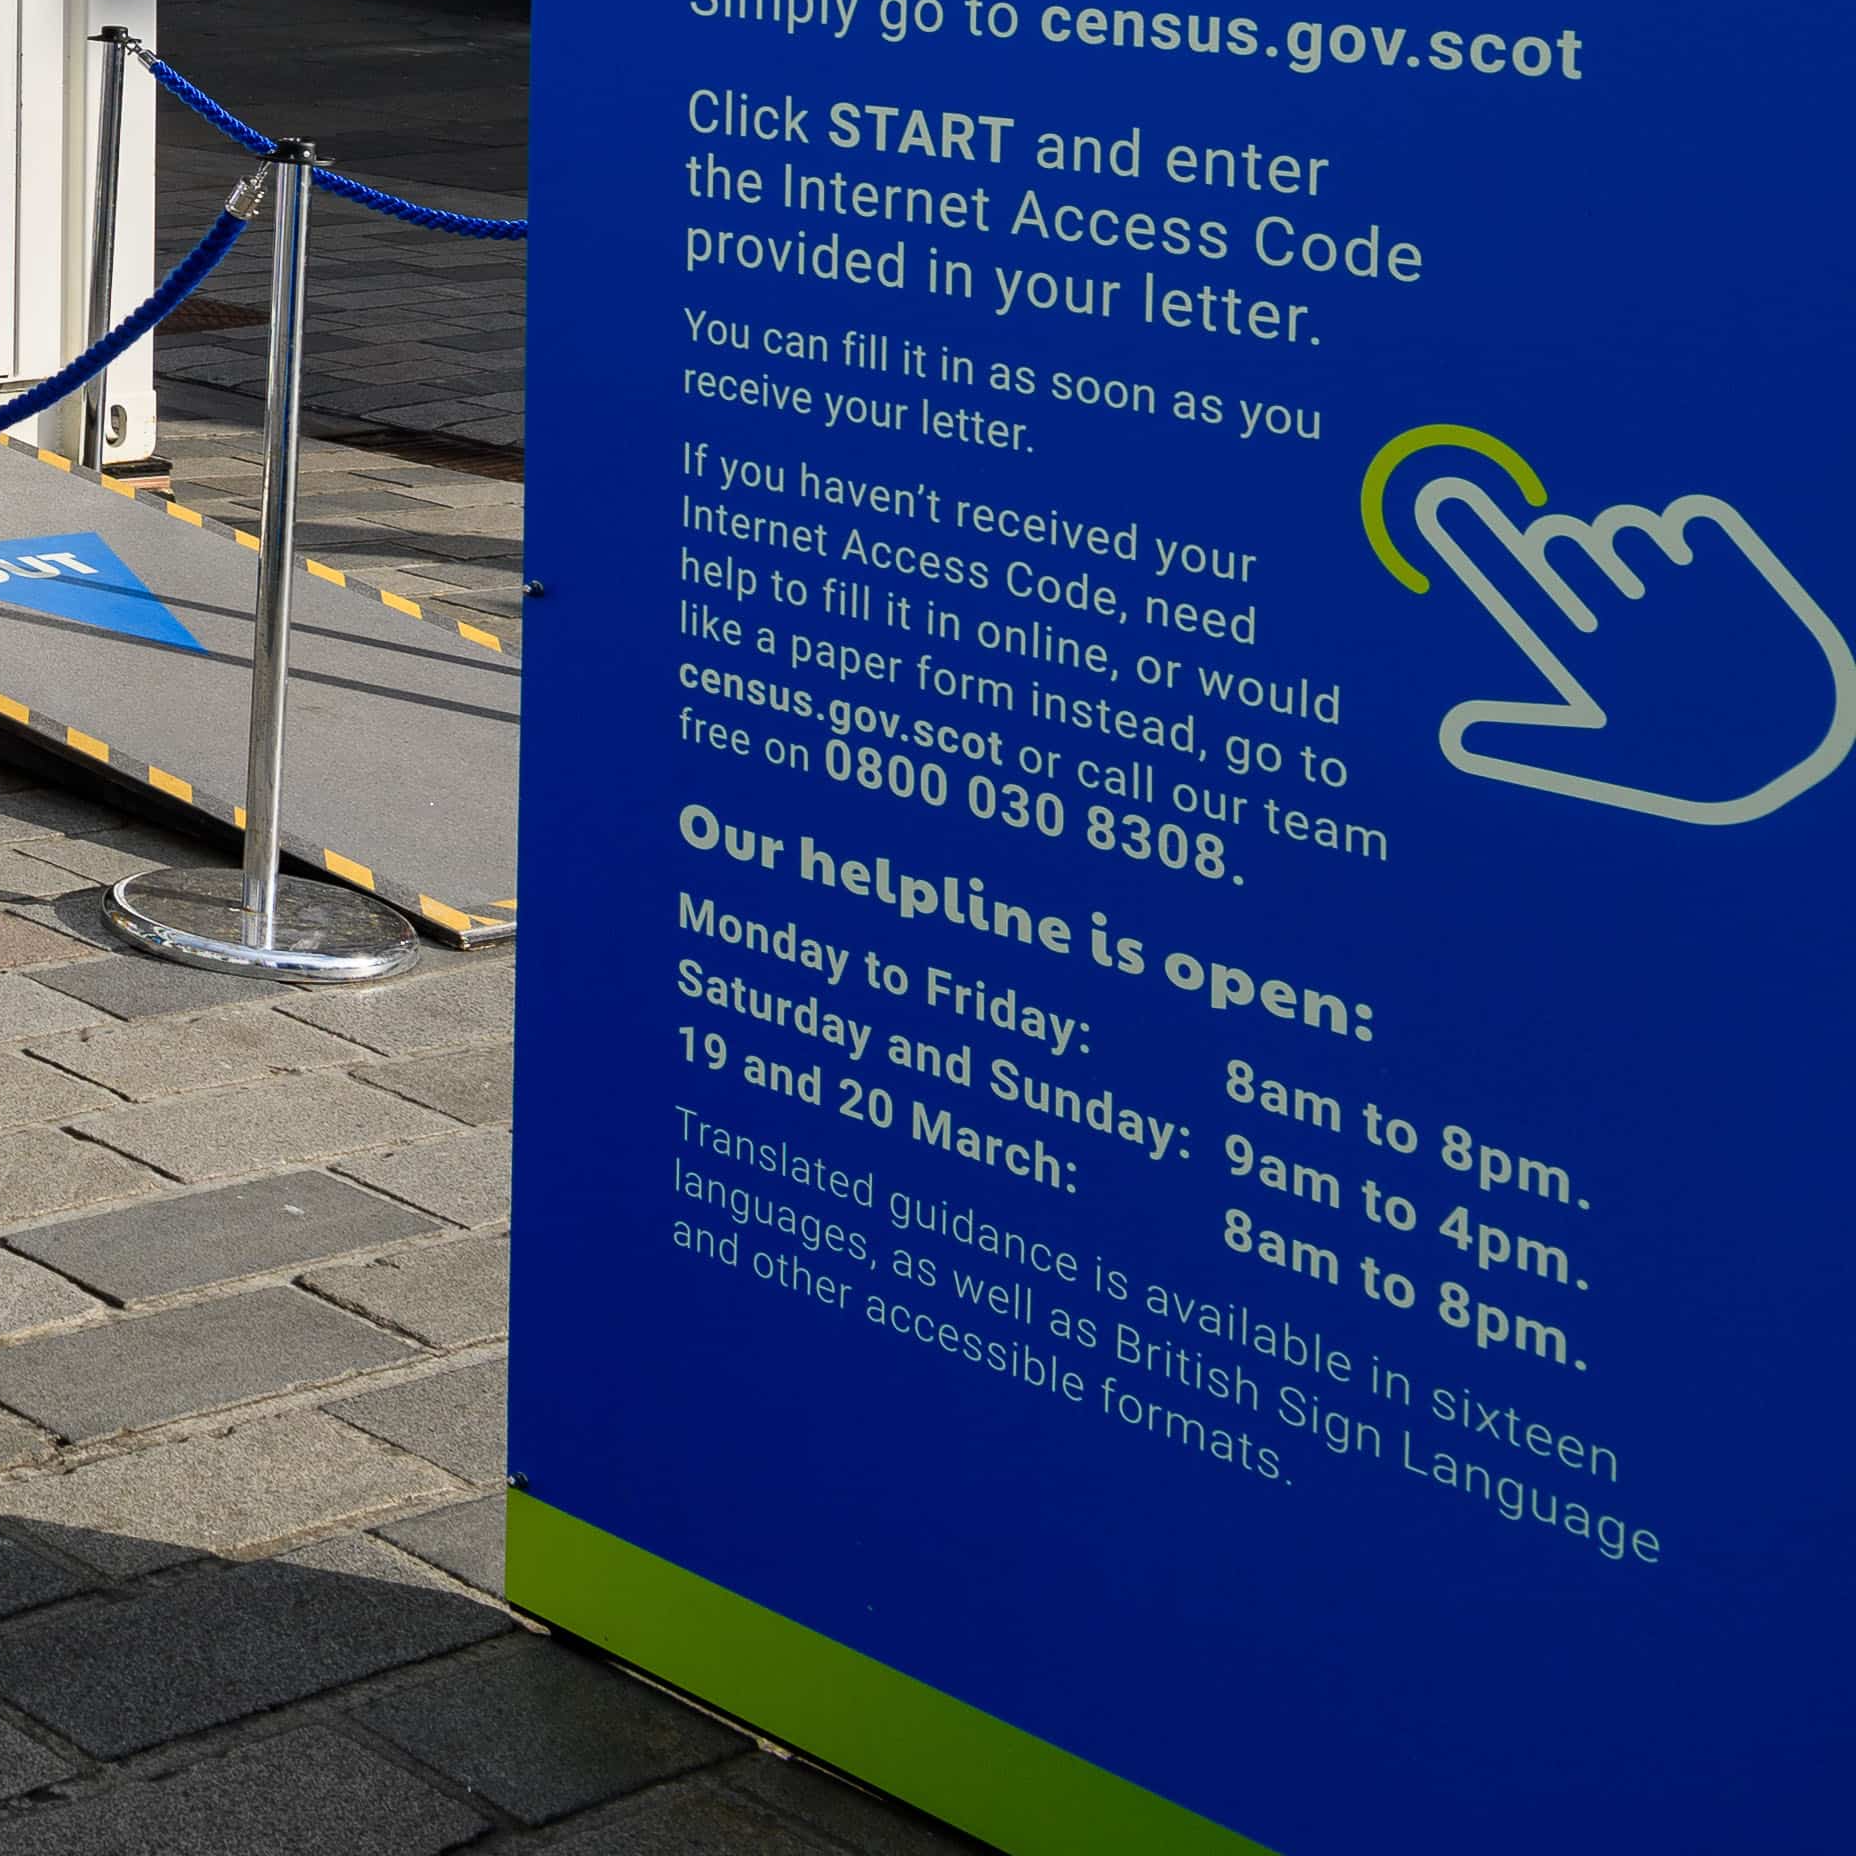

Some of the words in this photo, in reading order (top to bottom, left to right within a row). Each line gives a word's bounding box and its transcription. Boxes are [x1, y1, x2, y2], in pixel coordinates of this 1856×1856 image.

[1041, 5, 1582, 80] census.gov.scot
[685, 152, 763, 204] the
[784, 163, 990, 232] Internet
[1010, 190, 1228, 259] Access
[1255, 215, 1422, 282] Code
[689, 89, 809, 144] Click
[828, 102, 1015, 163] START
[1036, 127, 1140, 178] and
[1166, 143, 1329, 196] enter
[687, 227, 905, 289] provided
[929, 247, 972, 298] in
[995, 267, 1121, 317] your
[1145, 272, 1320, 346] letter.
[679, 706, 750, 756] free
[764, 738, 809, 772] on
[825, 738, 947, 807] 0800
[968, 775, 1064, 837] 030
[1087, 805, 1244, 886] 8308.
[679, 804, 785, 869] Our
[800, 836, 1071, 954] helpline
[1091, 911, 1145, 975] is
[1164, 952, 1373, 1042] open:
[679, 891, 849, 985] Monday
[864, 951, 909, 995] to
[927, 967, 1090, 1056] Friday:
[677, 958, 872, 1061] Saturday
[888, 1035, 971, 1087] and
[990, 1058, 1190, 1161] Sunday:
[679, 1026, 727, 1070] 19
[743, 1055, 821, 1106] and
[839, 1078, 893, 1129] 20
[912, 1101, 1076, 1193] March:
[1226, 1059, 1341, 1132] 8am
[1362, 1103, 1418, 1154] to
[1441, 1125, 1590, 1210] 8pm.
[1224, 1208, 1338, 1285] 8am
[1360, 1256, 1415, 1309] to
[1439, 1281, 1586, 1370] 8pm.
[1225, 1134, 1340, 1209] 9am
[1361, 1179, 1417, 1231] to
[1439, 1206, 1588, 1290] 4pm.
